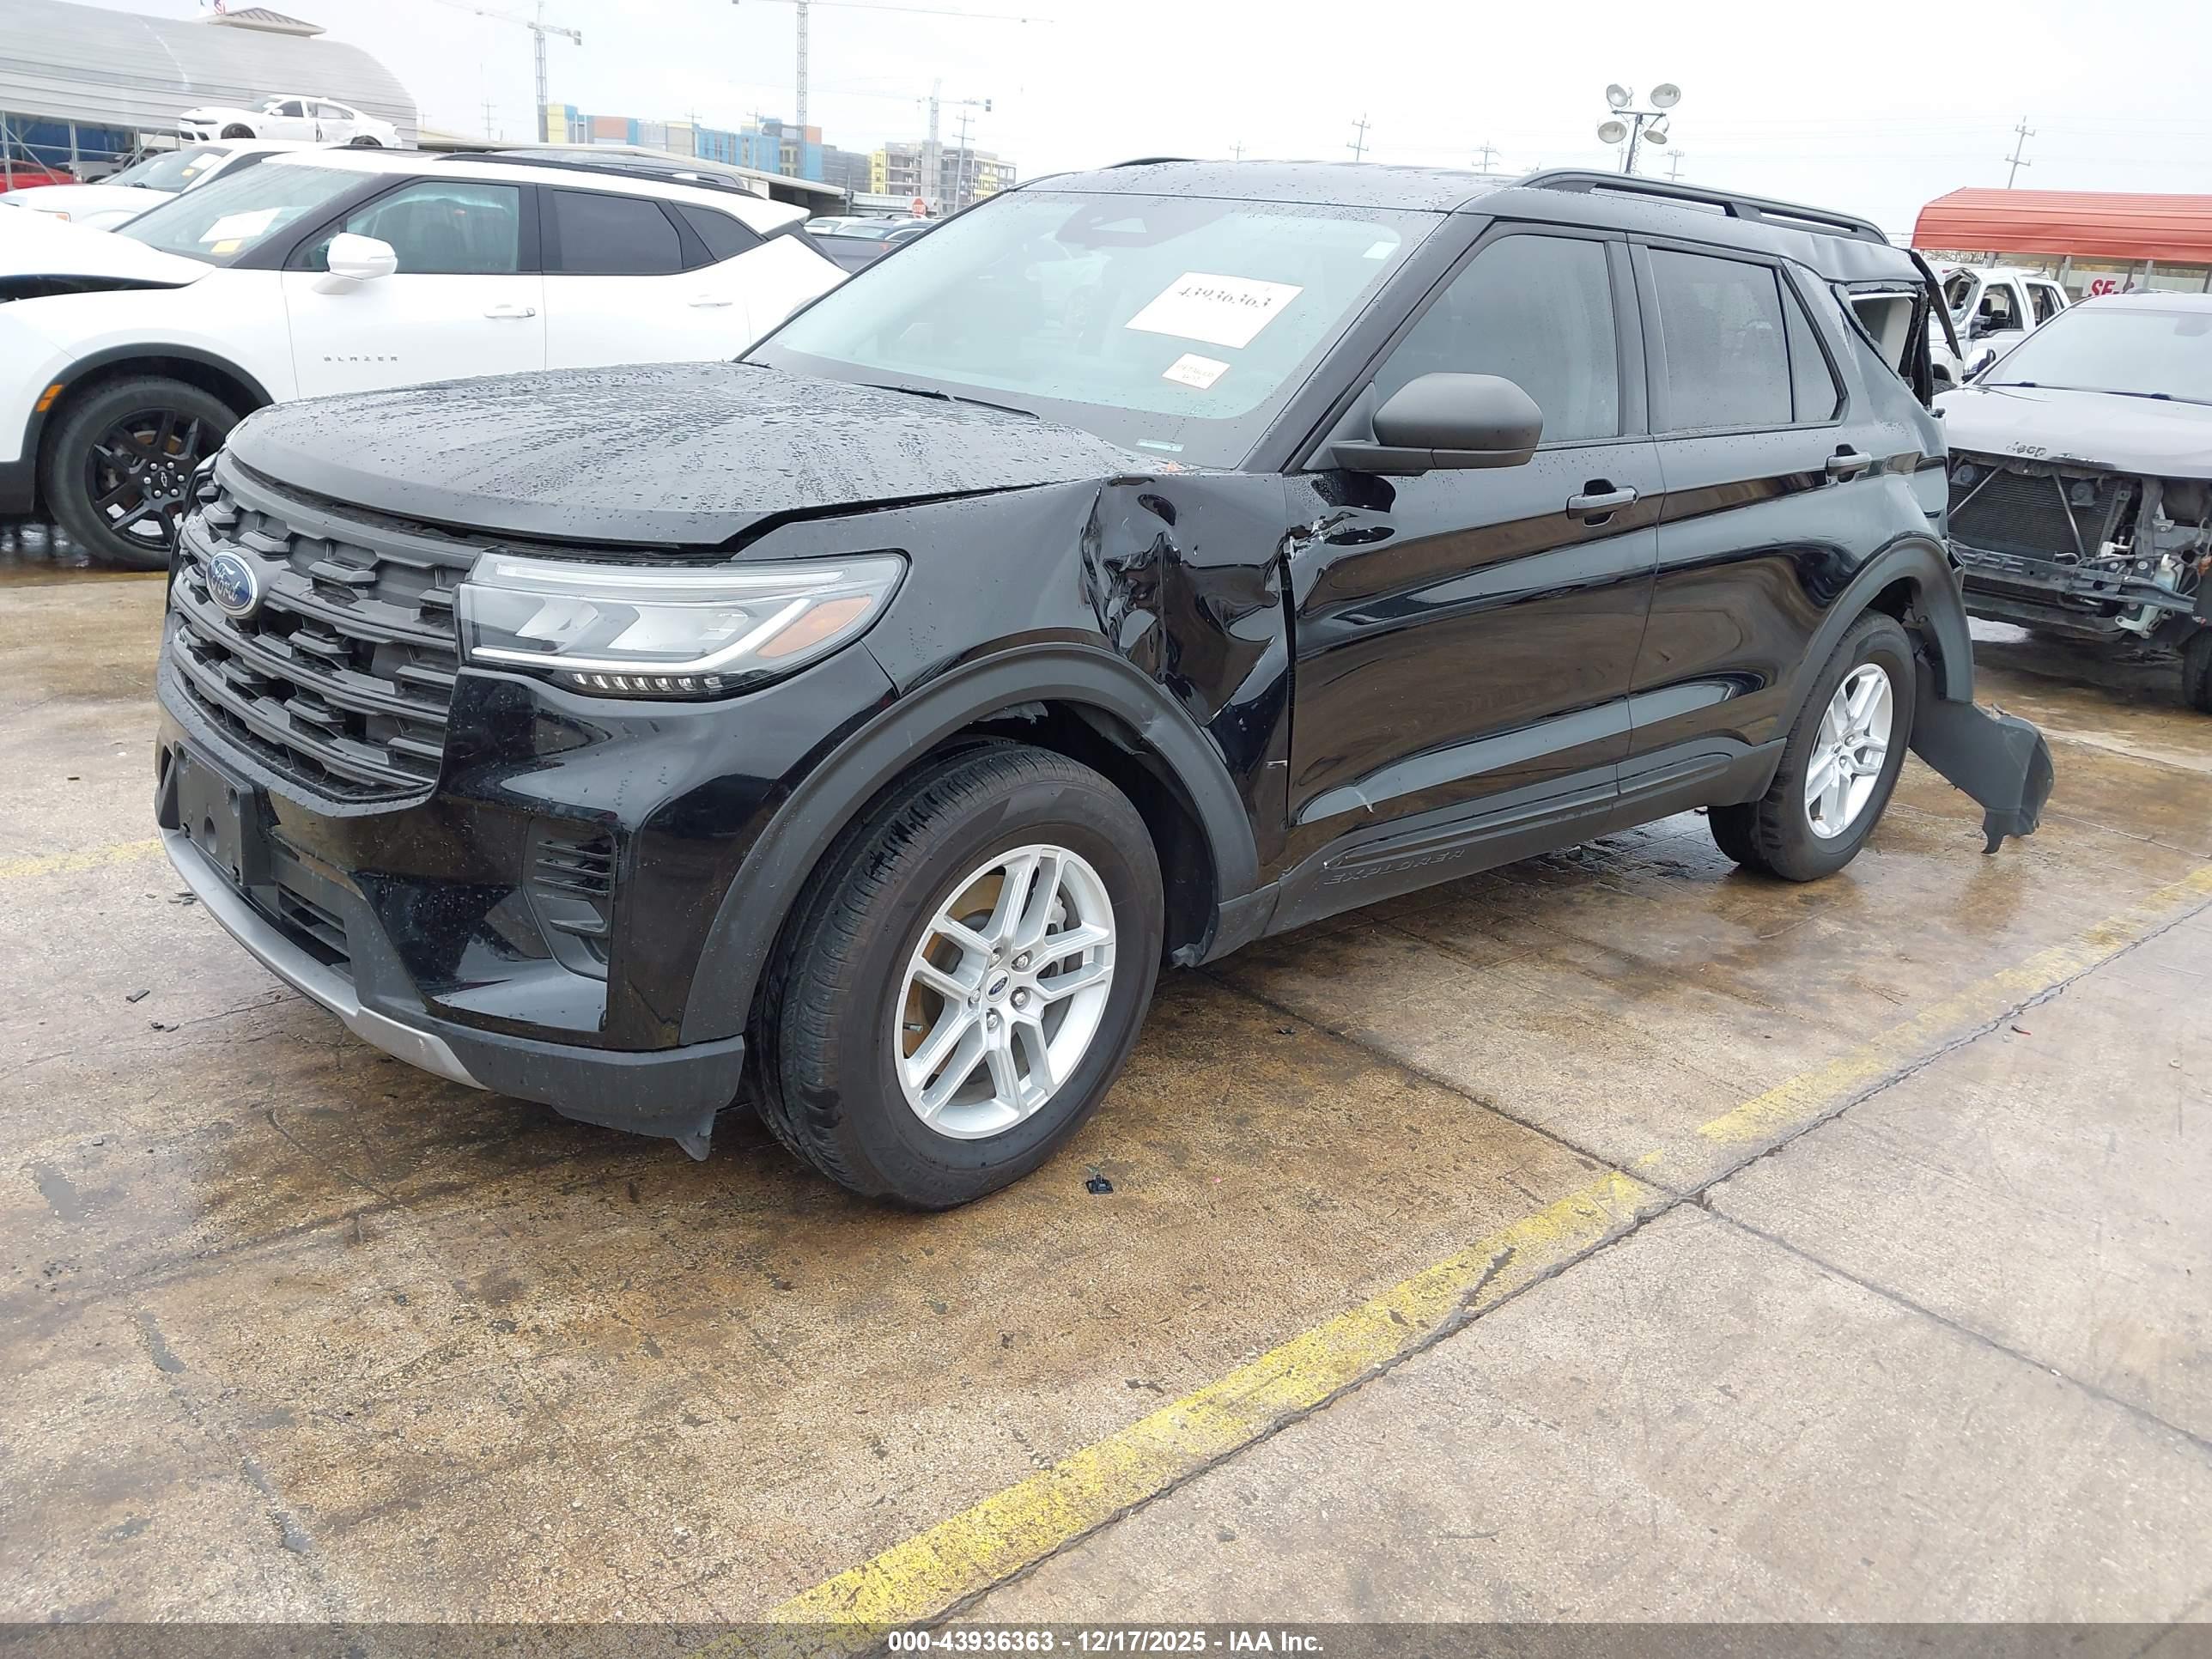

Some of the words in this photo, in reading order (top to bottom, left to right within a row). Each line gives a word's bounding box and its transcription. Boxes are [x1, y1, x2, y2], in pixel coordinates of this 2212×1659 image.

[2005, 441, 2048, 458] Jeep
[210, 560, 241, 602] Ford
[1323, 849, 1466, 885] EXPLORER
